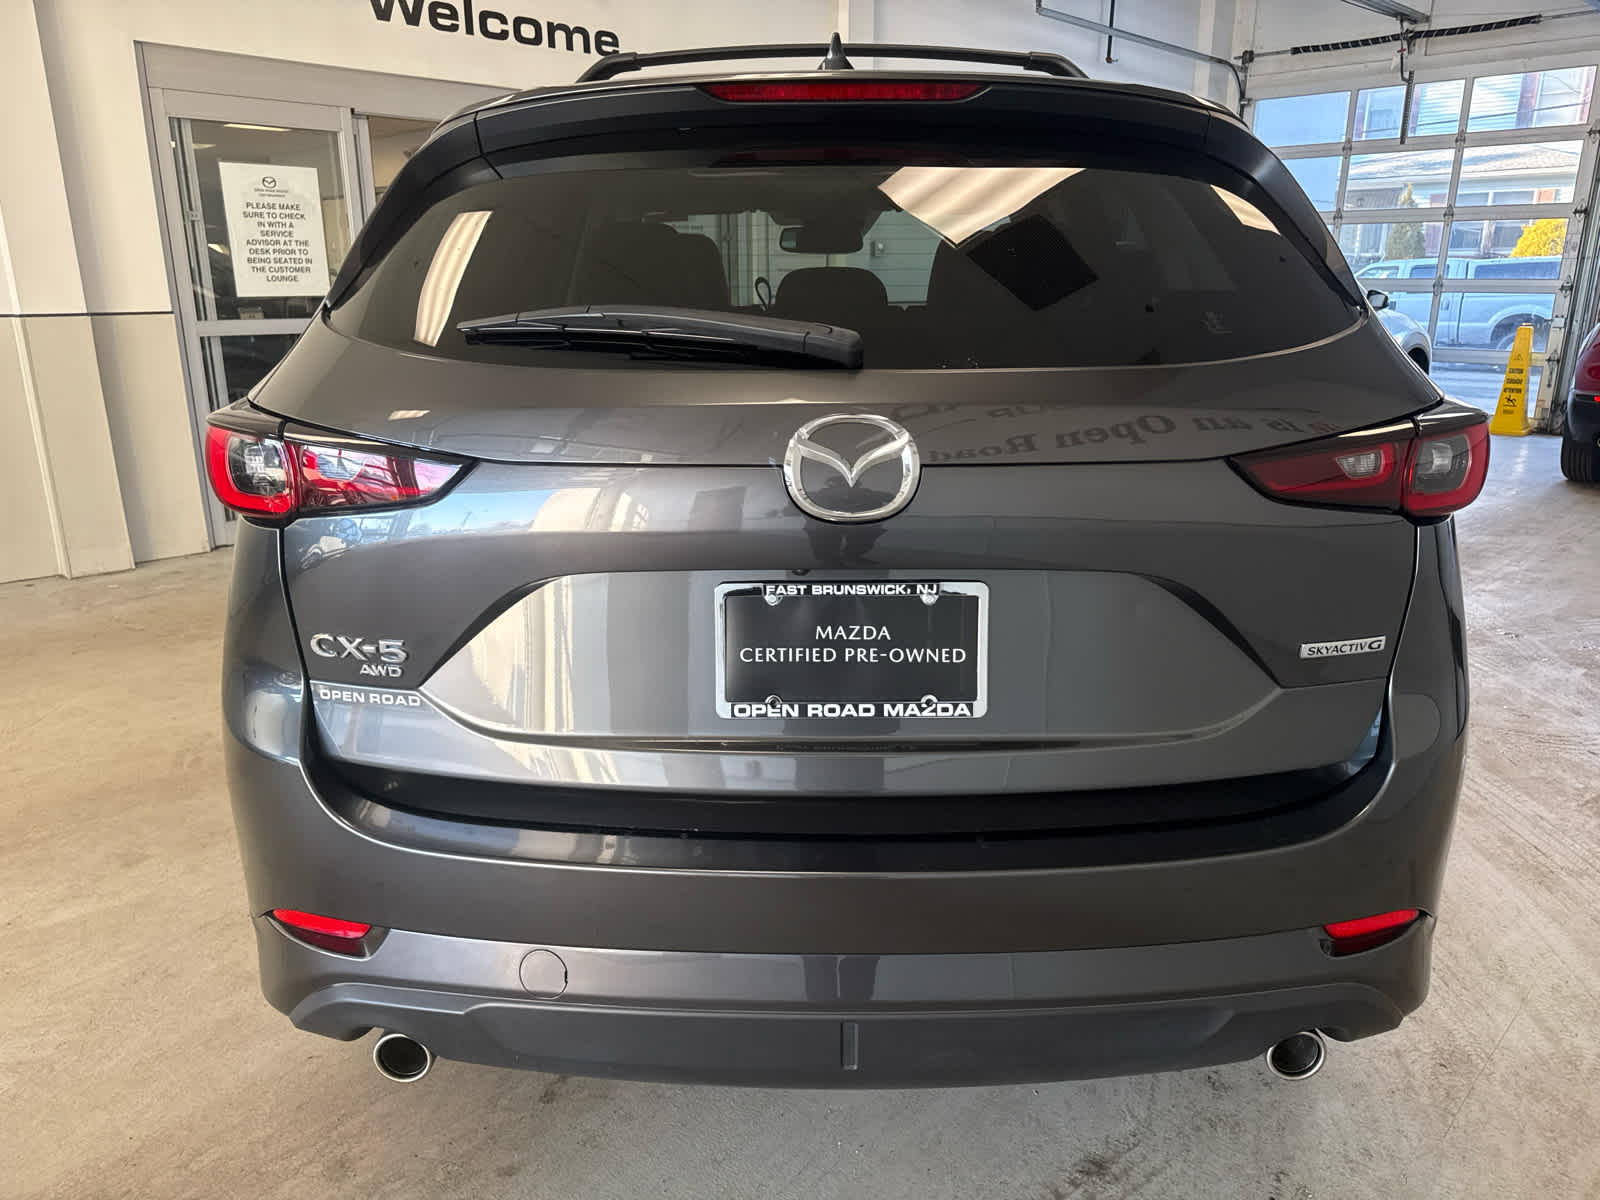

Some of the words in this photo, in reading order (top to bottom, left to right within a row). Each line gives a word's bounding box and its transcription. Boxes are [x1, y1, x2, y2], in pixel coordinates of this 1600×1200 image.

[370, 0, 620, 56] Welcome
[246, 202, 277, 210] PLEASE
[279, 203, 301, 211] MAKE
[242, 211, 265, 219] SURE
[266, 212, 278, 220] TO
[279, 212, 306, 220] CHECK
[257, 221, 266, 229] IN
[266, 221, 287, 229] WITH
[260, 230, 294, 238] SERVICE
[246, 239, 281, 247] ADVISOR
[282, 239, 293, 247] AT
[249, 248, 271, 256] DESK
[272, 248, 296, 256] PRIOR
[298, 248, 309, 256] TO
[247, 257, 271, 265] BEING
[273, 257, 303, 265] SEATED
[268, 266, 311, 274] CUSTOMER
[266, 275, 299, 283] LOUNGE
[811, 584, 912, 596] BRUNSWICK,
[916, 584, 938, 595] NJ
[815, 625, 891, 640] MAZDA
[310, 633, 408, 663] CX-5
[739, 647, 837, 663] CERTIFIED
[844, 647, 967, 663] PRE-OWNED
[359, 664, 402, 677] AWD
[320, 689, 365, 703] OPEN
[369, 693, 421, 706] ROAD
[733, 703, 799, 718] OPEN
[807, 703, 876, 718] ROAD
[883, 703, 971, 717] MAZDA
